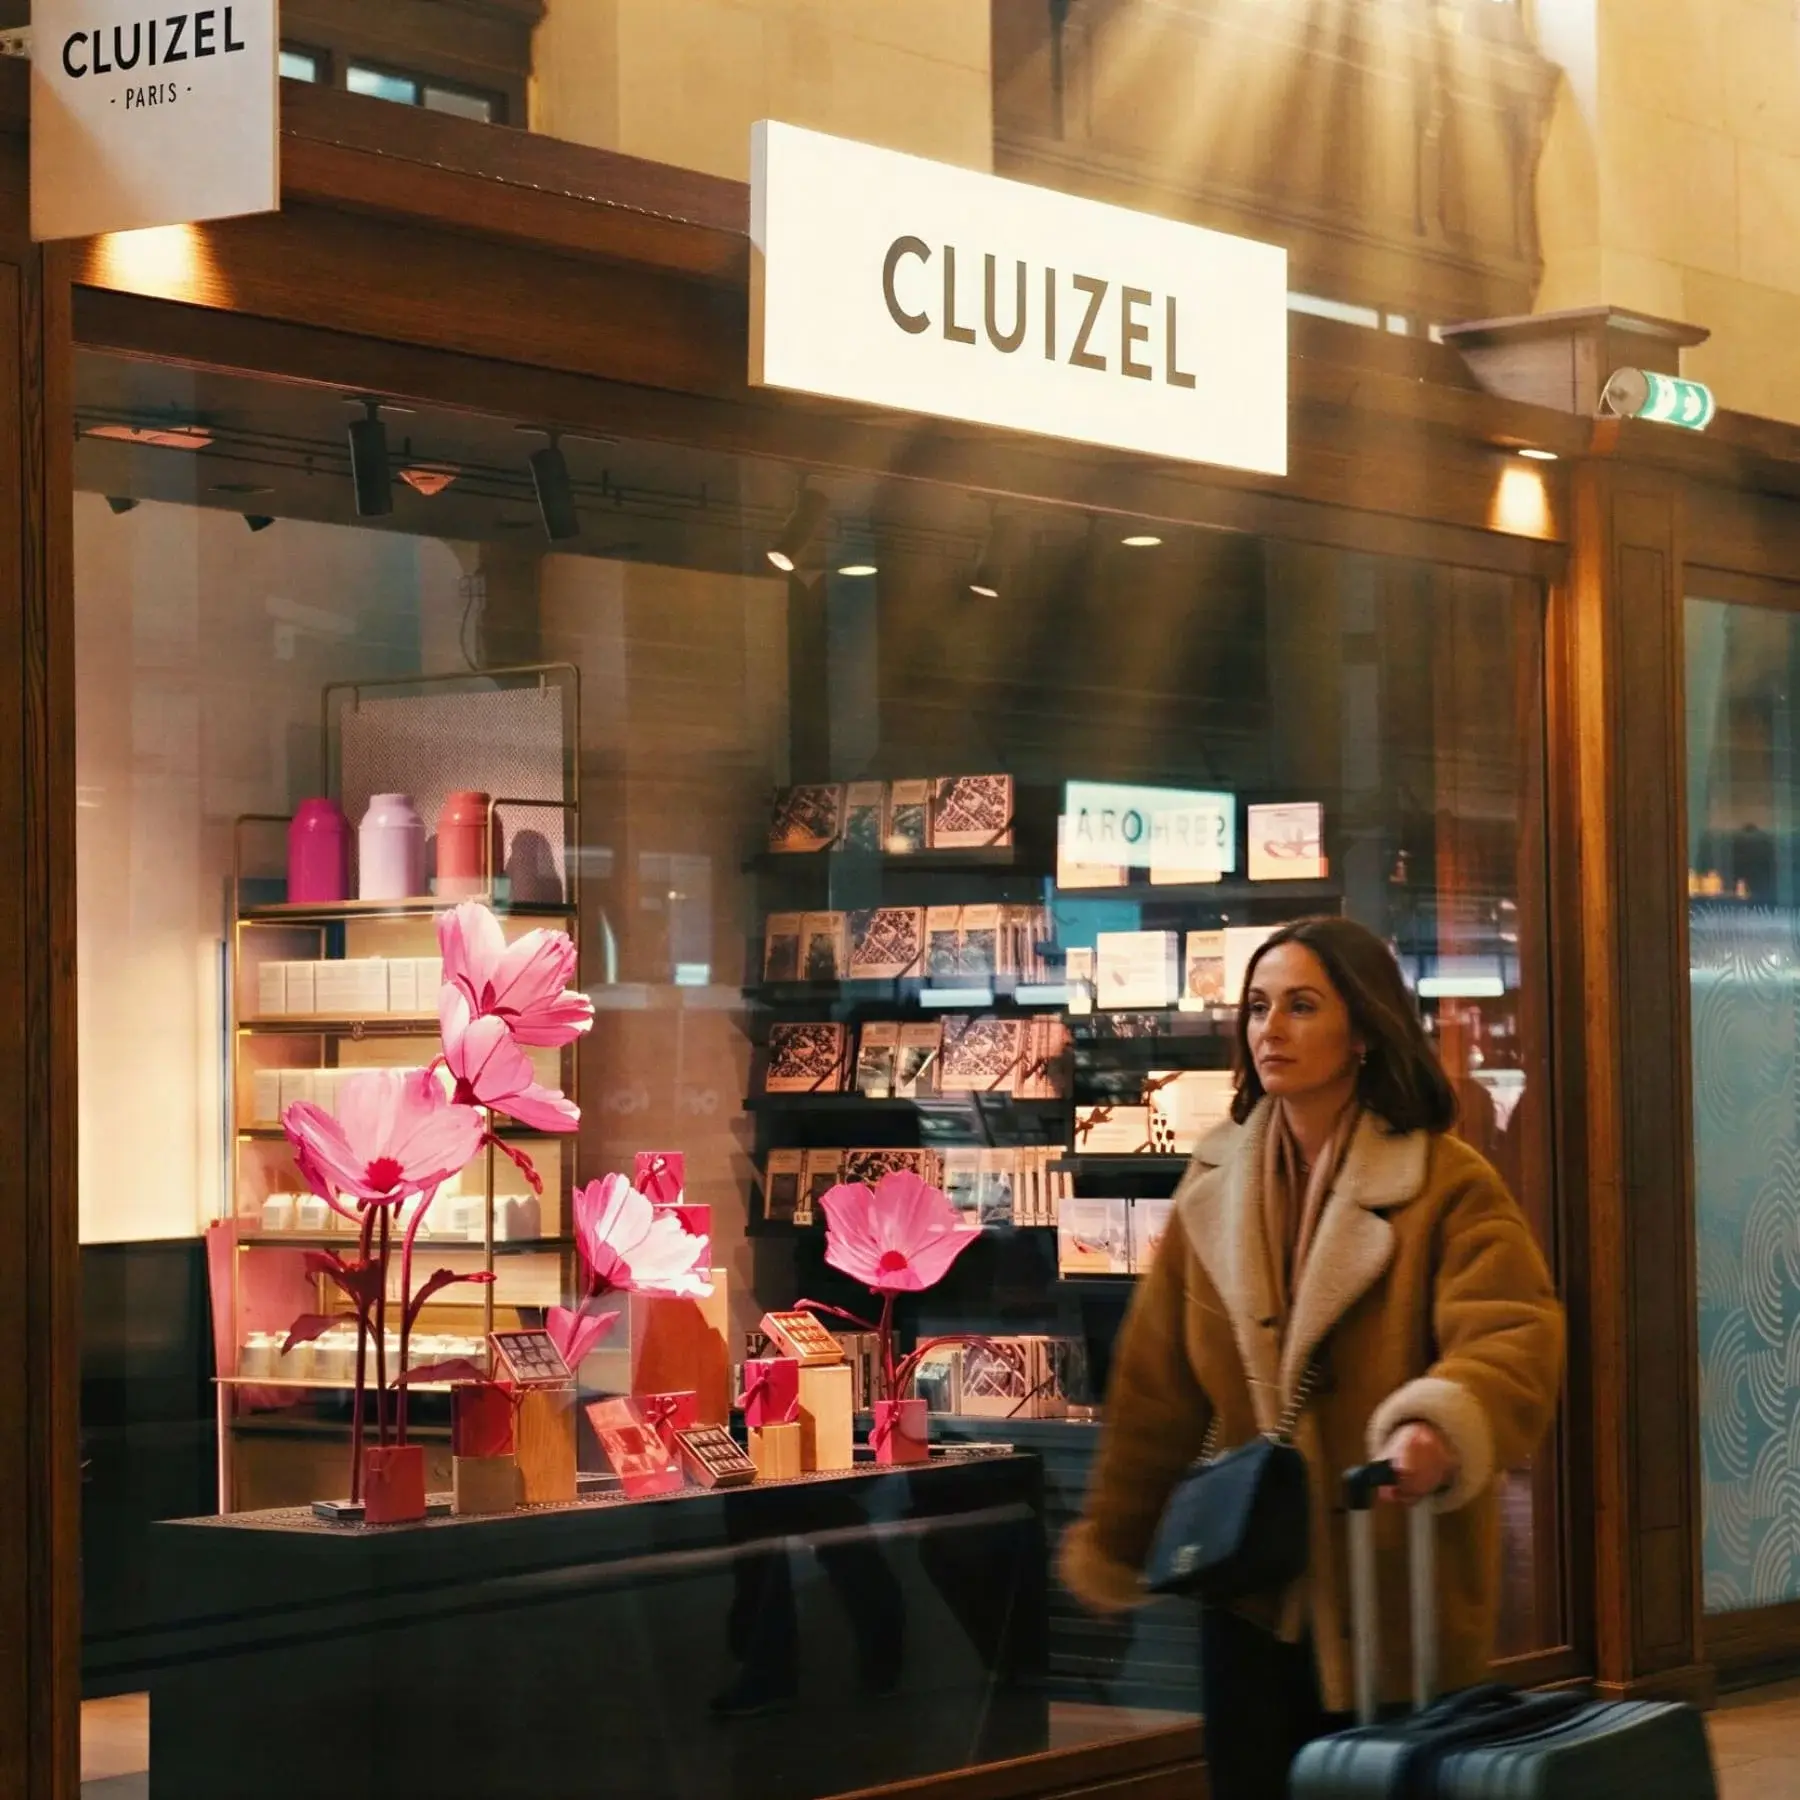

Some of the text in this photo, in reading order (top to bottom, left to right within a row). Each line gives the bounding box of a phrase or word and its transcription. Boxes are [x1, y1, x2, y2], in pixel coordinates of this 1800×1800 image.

[62, 6, 245, 78] CLUIZEL
[125, 82, 177, 110] PARIS
[882, 235, 1197, 389] CLUIZEL
